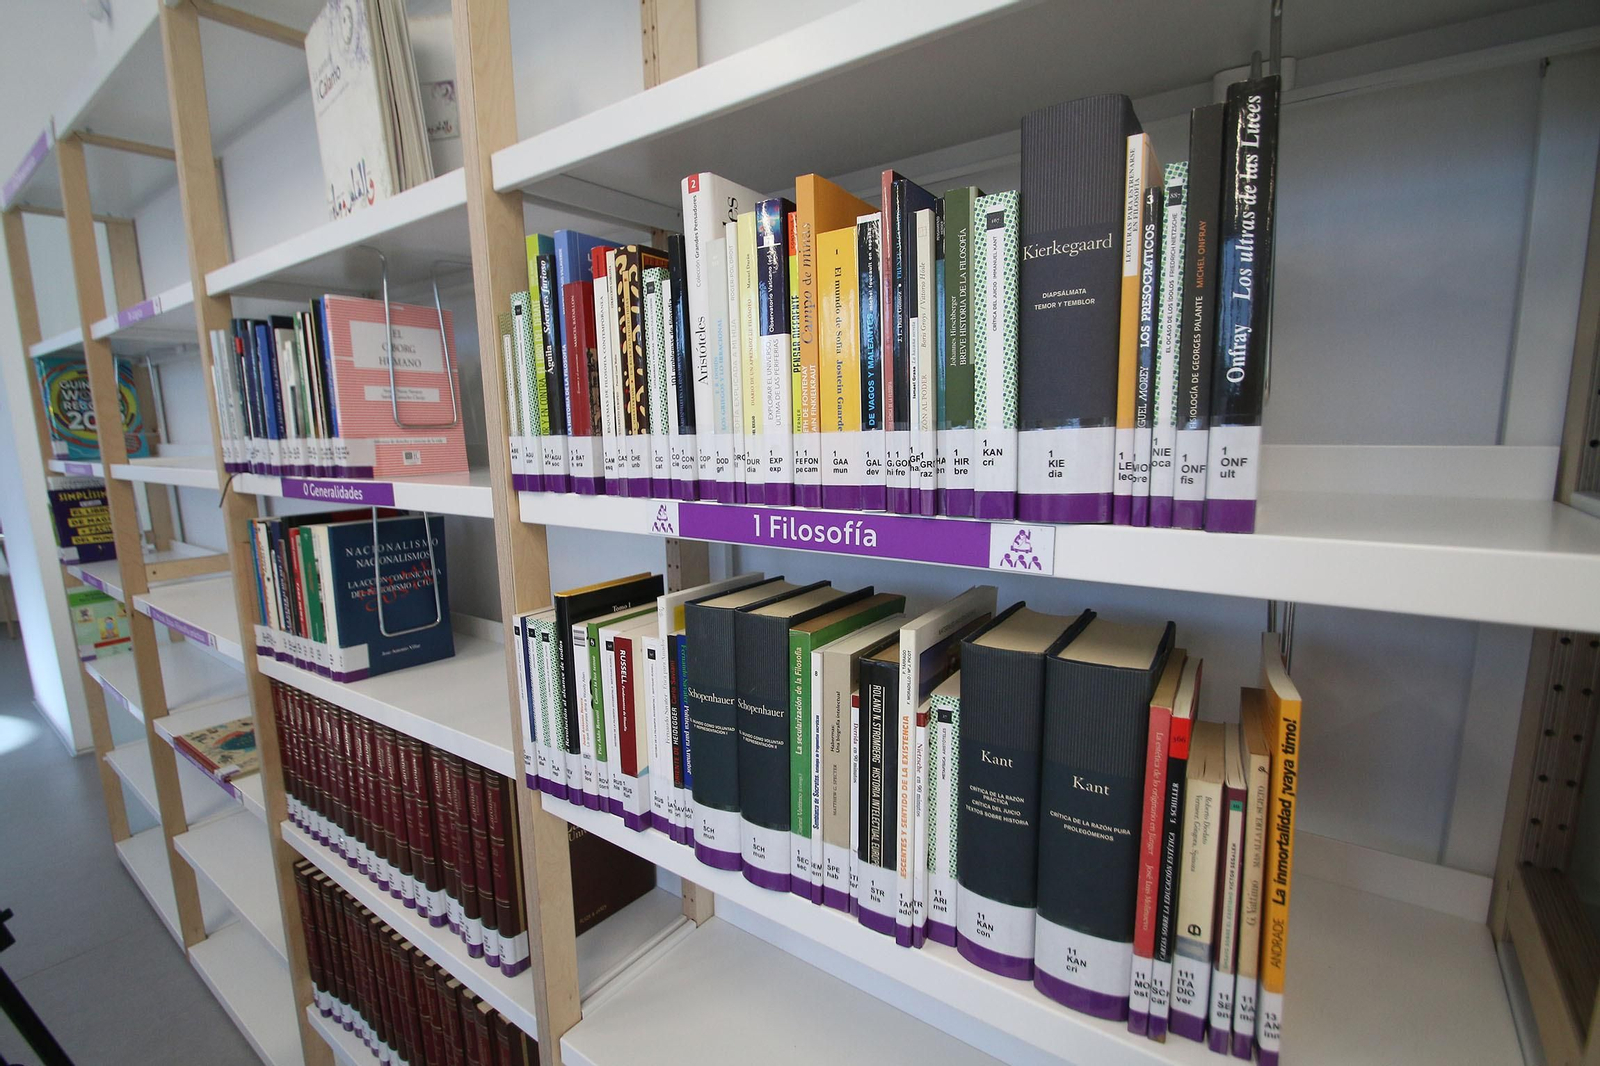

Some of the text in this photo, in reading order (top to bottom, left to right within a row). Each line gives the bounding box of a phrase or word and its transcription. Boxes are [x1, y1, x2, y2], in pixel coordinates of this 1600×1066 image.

[1128, 148, 1136, 199] ESTRENARSE
[690, 179, 697, 189] 2
[1126, 219, 1134, 262] LECTURAS
[1198, 220, 1207, 254] ONFRAY
[1226, 95, 1261, 383] Onfray Los ultras de las Luces
[1023, 232, 1113, 262] Kierkegaard
[834, 267, 842, 277] El
[1141, 223, 1155, 322] PRESOCRATICOS
[1167, 314, 1173, 323] DE
[1170, 213, 1178, 244] NIETZSCHE
[1196, 255, 1206, 289] MICHEL
[539, 260, 550, 294] furioso
[798, 222, 815, 345] Campo de minas
[959, 272, 967, 284] LA
[834, 280, 843, 314] mundo
[959, 285, 967, 297] DE
[1034, 298, 1096, 310] TEMOR TEMBLOR
[541, 295, 552, 334] Sócrates
[767, 293, 775, 333] Observatorio
[950, 295, 958, 337] Hirschberger
[959, 298, 967, 337] HISTORIA
[1194, 295, 1203, 332] PALANTE
[835, 316, 843, 328] de
[1140, 325, 1150, 348] LOS
[381, 342, 417, 354] CBORG
[694, 316, 709, 386] Aristóteles
[959, 339, 967, 366] BREVE
[1193, 332, 1201, 369] GEORGES
[772, 339, 780, 376] PERIFERIAS
[866, 313, 875, 426] DE VAGOS MALEANTES
[1192, 369, 1199, 383] DE
[765, 339, 774, 420] EXPLORAR UNIVERSO,
[836, 359, 844, 395] Jostein
[1138, 366, 1149, 401] MOREY
[801, 365, 809, 406] FONTENAY
[809, 364, 817, 416] FINKIELKRAUT
[681, 455, 695, 463] CON
[982, 448, 1003, 457] KAN
[1152, 447, 1171, 457] NIE
[716, 457, 729, 465] DOD
[747, 458, 760, 466] DUR
[769, 457, 783, 465] EXP
[804, 457, 819, 465] FON
[833, 458, 849, 466] GAA
[866, 459, 882, 467] GAL
[954, 457, 970, 466] HIR
[982, 458, 994, 467] cri
[1048, 459, 1066, 468] KIE
[1151, 459, 1171, 468] oca
[1220, 457, 1248, 467] ONF
[866, 468, 880, 476] dev
[954, 467, 968, 475] bre
[1048, 469, 1063, 478] dia
[1181, 464, 1206, 474] ONF
[1219, 469, 1236, 479] ult
[1180, 475, 1194, 485] fis
[303, 481, 364, 501] 0 Generalidades
[753, 514, 878, 548] 1 Filosofía
[355, 550, 431, 569] NACONALISMOS
[619, 649, 628, 685] RUSSELL
[687, 686, 736, 706] Schopenhauer
[872, 684, 882, 713] ROLAND
[737, 698, 785, 718] Schopenhauer
[669, 687, 680, 746] HEIDEGGER Carlo
[794, 696, 803, 746] secularización
[852, 722, 860, 746] Derrida
[901, 715, 909, 766] EXISTENCIA
[871, 721, 882, 763] STROMBERG
[794, 746, 803, 755] La
[981, 749, 1014, 769] Kant
[901, 768, 909, 778] LA
[871, 766, 881, 798] HISTORIA
[901, 779, 908, 791] DE
[1072, 774, 1110, 797] Kant
[831, 791, 839, 816] MATTHEW
[1170, 782, 1179, 817] SCHILLER
[871, 799, 881, 841] INTELECTUAL
[965, 804, 1030, 827] TEXTOS SOBRE HISTORIA
[703, 826, 715, 834] SCH
[1113, 826, 1132, 836] PURA
[753, 844, 766, 853] SCH
[1269, 717, 1298, 969] ANDRADE La inmortalidad ¡vaya timo!
[796, 856, 809, 866] SEC
[826, 864, 840, 874] SPE
[826, 871, 839, 880] hab
[870, 887, 885, 897] STR
[933, 895, 947, 905] ARI
[933, 903, 948, 913] met
[1163, 904, 1171, 914] LA
[976, 919, 994, 932] KAN
[1161, 914, 1171, 936] SOBRE
[976, 928, 991, 938] con
[1159, 936, 1168, 961] CARTAS
[1066, 955, 1087, 968] KAN
[1066, 964, 1078, 973] cri
[1178, 969, 1195, 980] 111
[1177, 978, 1194, 988] ITA
[1176, 986, 1196, 997] DIO
[1151, 996, 1167, 1006] car
[1176, 996, 1192, 1005] ver
